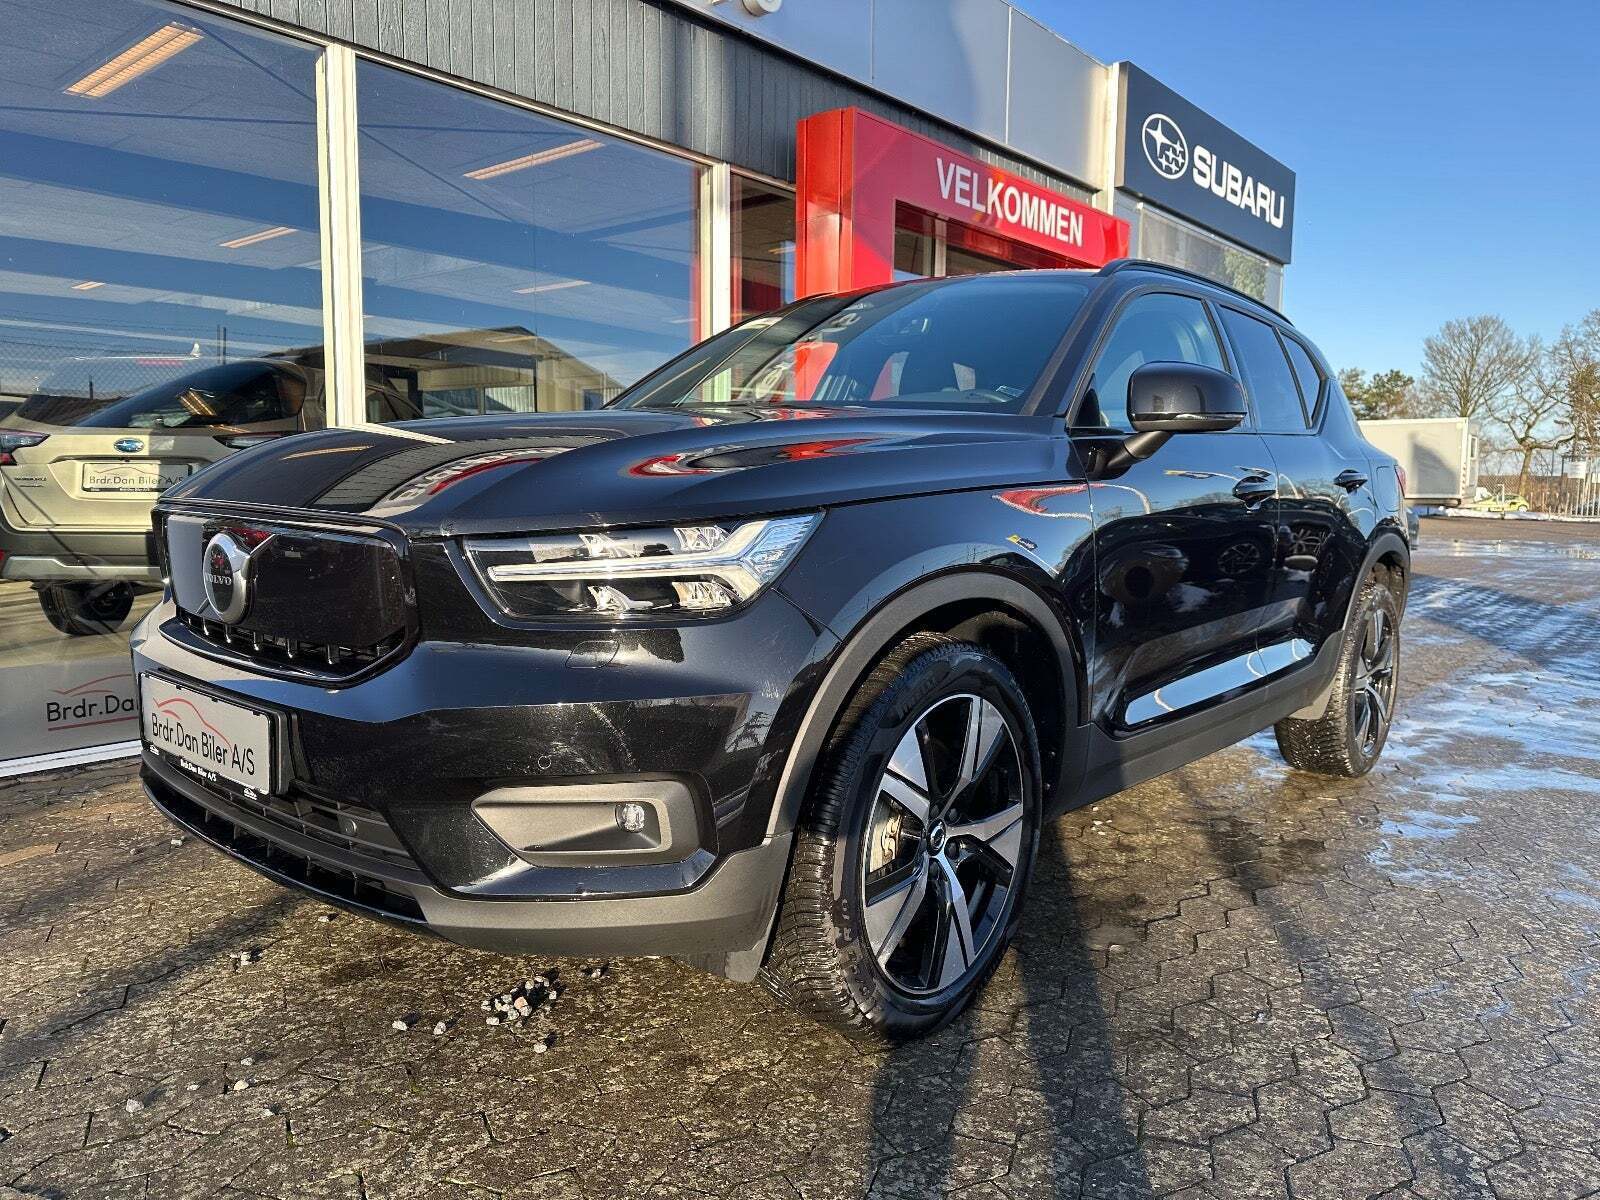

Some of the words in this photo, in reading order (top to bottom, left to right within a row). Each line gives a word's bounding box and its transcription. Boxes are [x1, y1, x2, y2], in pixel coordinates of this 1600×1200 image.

[936, 157, 1084, 248] VELKOMMEN
[1192, 144, 1285, 230] SUBARU
[89, 476, 135, 485] Brdr.Dan
[204, 572, 232, 586] VOLVO
[46, 694, 139, 722] Brdr.Da
[151, 712, 199, 755] Brdr.Dan
[201, 732, 228, 766] Biler
[231, 743, 256, 777] A/S
